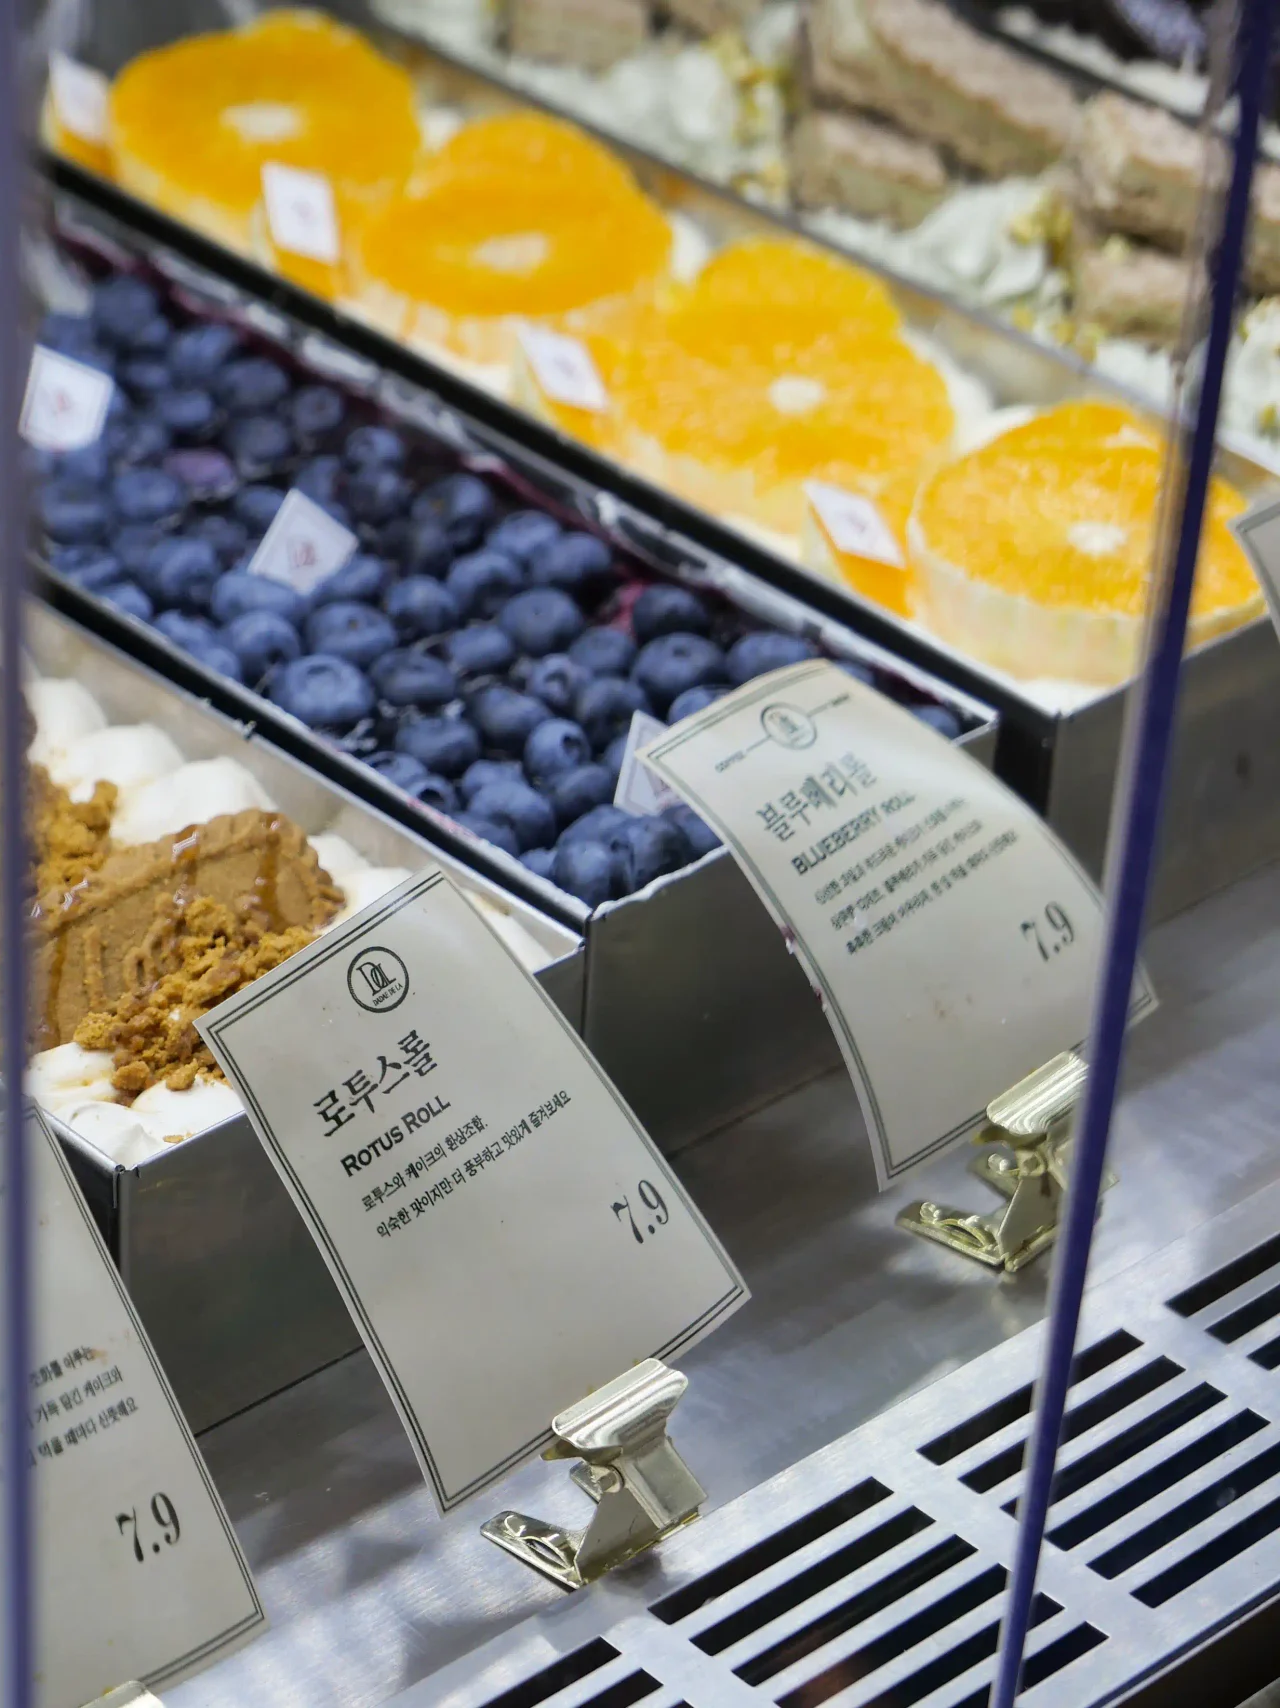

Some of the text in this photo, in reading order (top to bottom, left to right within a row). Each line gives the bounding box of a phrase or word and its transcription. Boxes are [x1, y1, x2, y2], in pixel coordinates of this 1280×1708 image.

[791, 806, 882, 875] BLUEBERRY
[1020, 901, 1074, 962] 7.9
[313, 1029, 438, 1137] 로투스롤
[340, 1095, 451, 1177] ROTUS ROLL
[361, 1115, 489, 1212] 로투스와 케이크의 환상조합.
[410, 1177, 454, 1218] 맛이지만
[452, 1167, 467, 1185] 더
[464, 1141, 505, 1177] 풍부하고
[501, 1118, 532, 1150] 맛있게
[528, 1090, 571, 1128] 즐겨보세요
[610, 1180, 669, 1244] 7.9
[83, 1365, 123, 1397] 케이크와
[115, 1492, 180, 1563] 7.9
